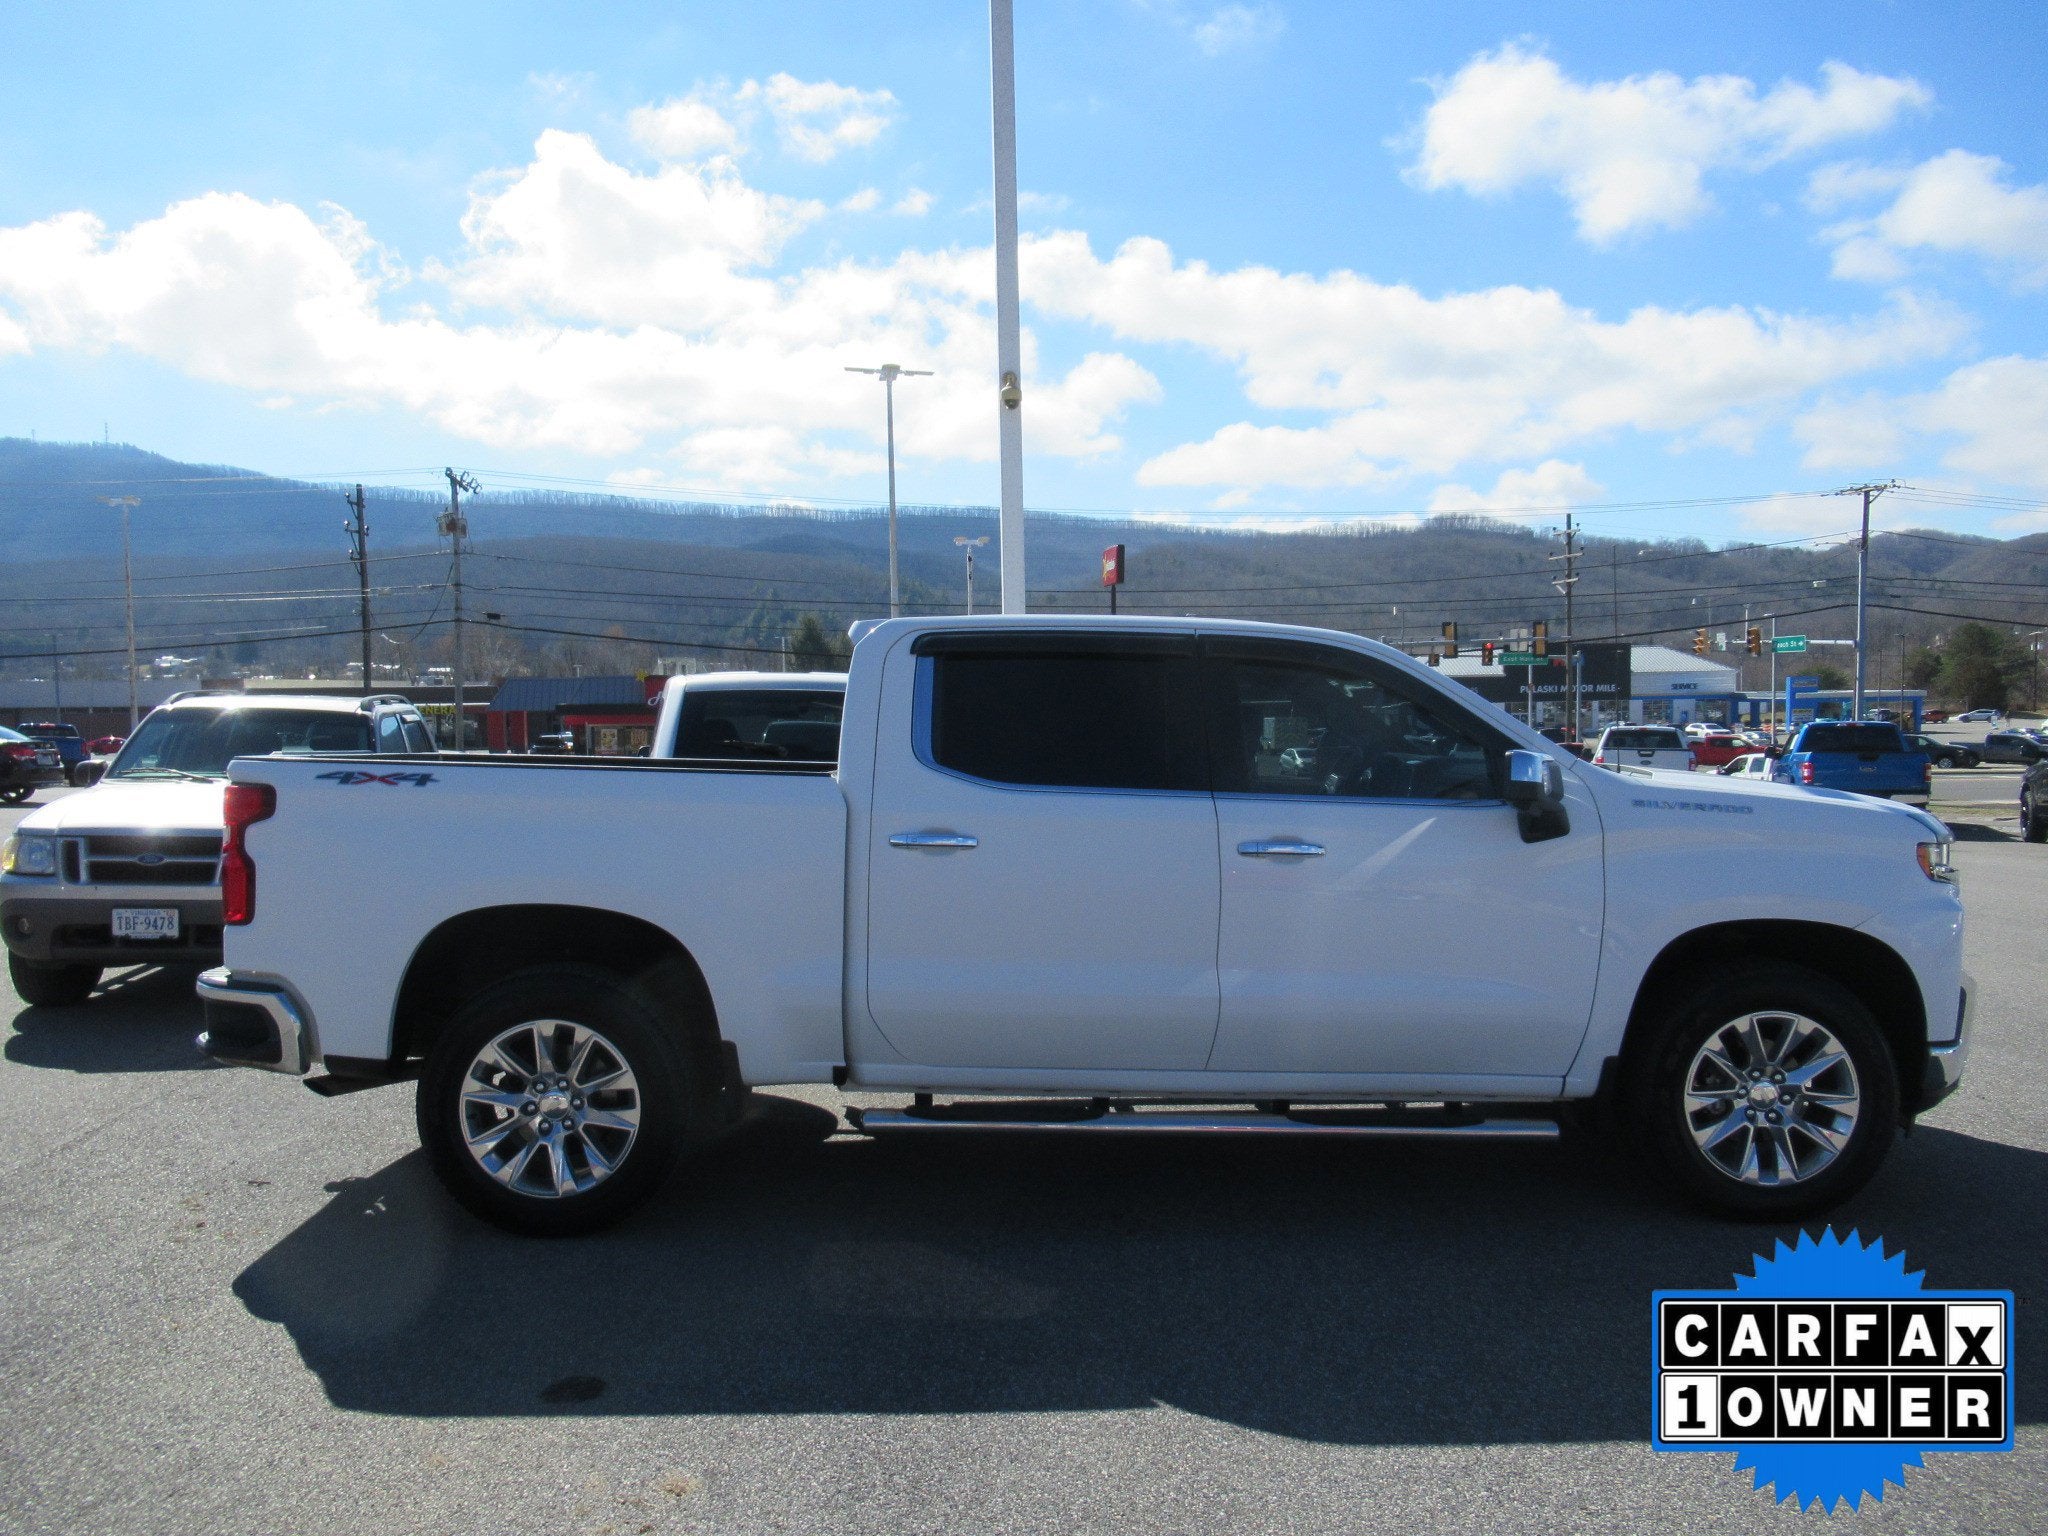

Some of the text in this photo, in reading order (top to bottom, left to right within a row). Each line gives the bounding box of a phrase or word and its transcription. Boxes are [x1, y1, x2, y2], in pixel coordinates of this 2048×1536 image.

[1596, 684, 1616, 692] MILE
[1632, 799, 1753, 814] SILVERADO
[116, 916, 175, 931] TBF-9478
